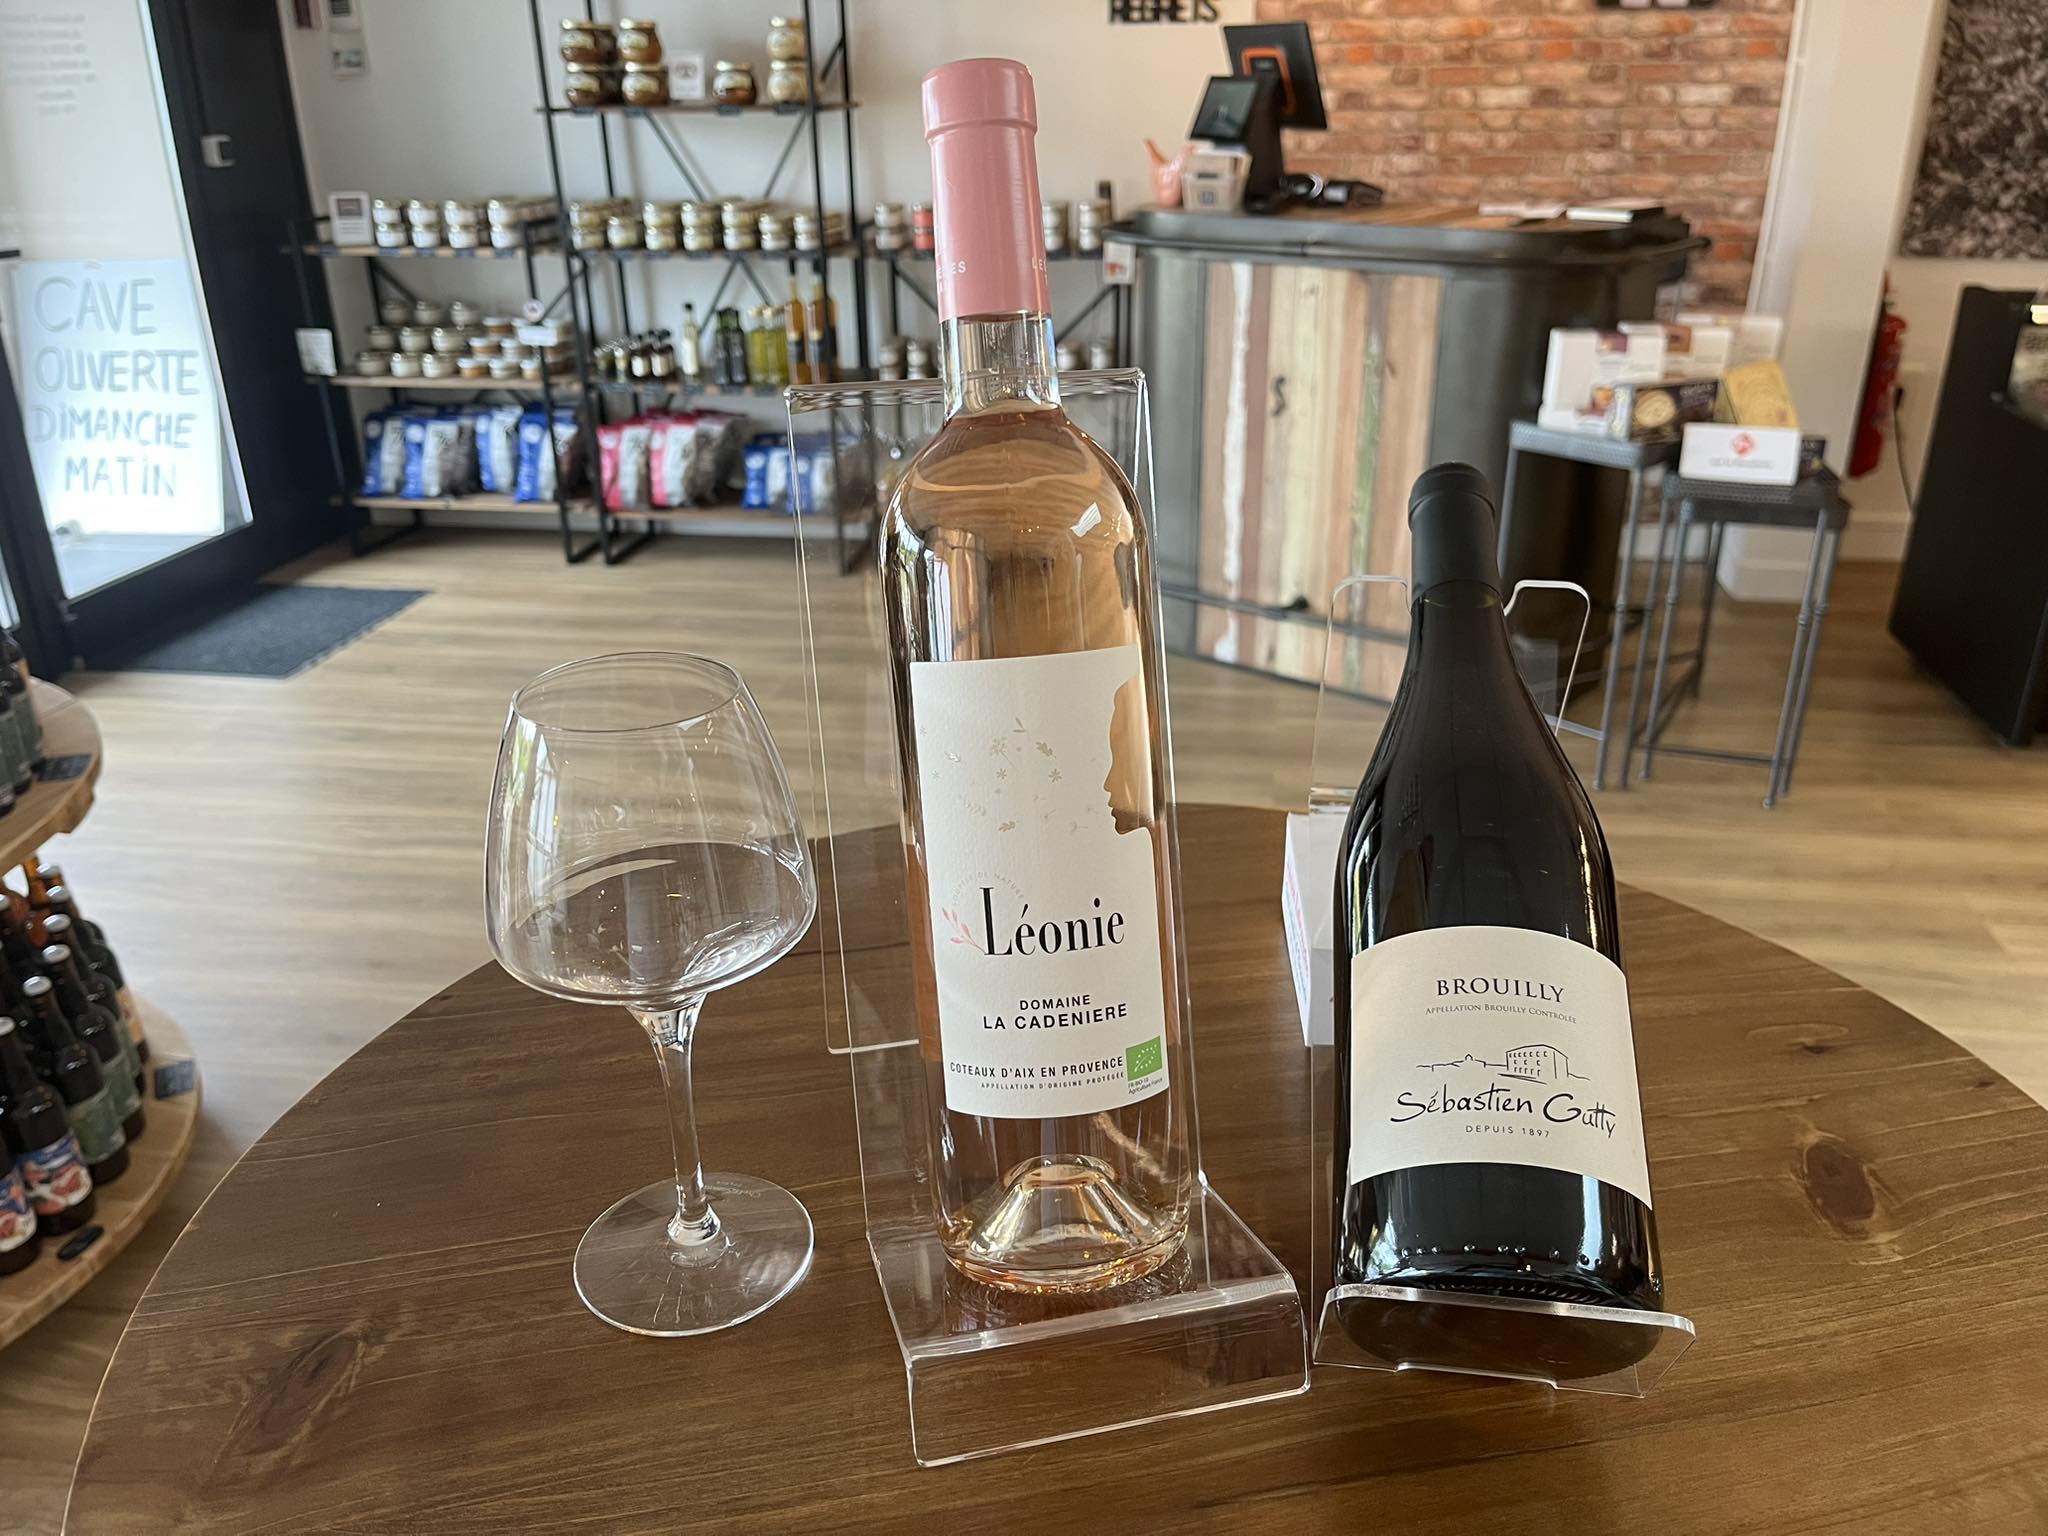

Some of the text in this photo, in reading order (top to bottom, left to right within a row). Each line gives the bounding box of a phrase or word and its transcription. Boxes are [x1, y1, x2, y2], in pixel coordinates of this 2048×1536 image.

[34, 276, 158, 335] CAVE
[35, 347, 199, 395] OUVERTE
[31, 402, 197, 448] DIMANCHE
[65, 456, 177, 496] MATIN
[979, 887, 1126, 956] Léonie
[1019, 995, 1091, 1010] DOMAINE
[1436, 977, 1564, 1003] BROUILLY
[983, 1003, 1127, 1030] LA CADENIERE
[1425, 1004, 1482, 1015] APPELLATION
[1484, 1003, 1526, 1014] BROUILLY
[950, 1056, 1123, 1078] COTEAUX D'AIX EN PROVENCE
[981, 1082, 1035, 1090] APPELLATION
[1390, 1082, 1616, 1138] Sébastien Gutty
[1465, 1125, 1550, 1138] DEPUIS 1897
